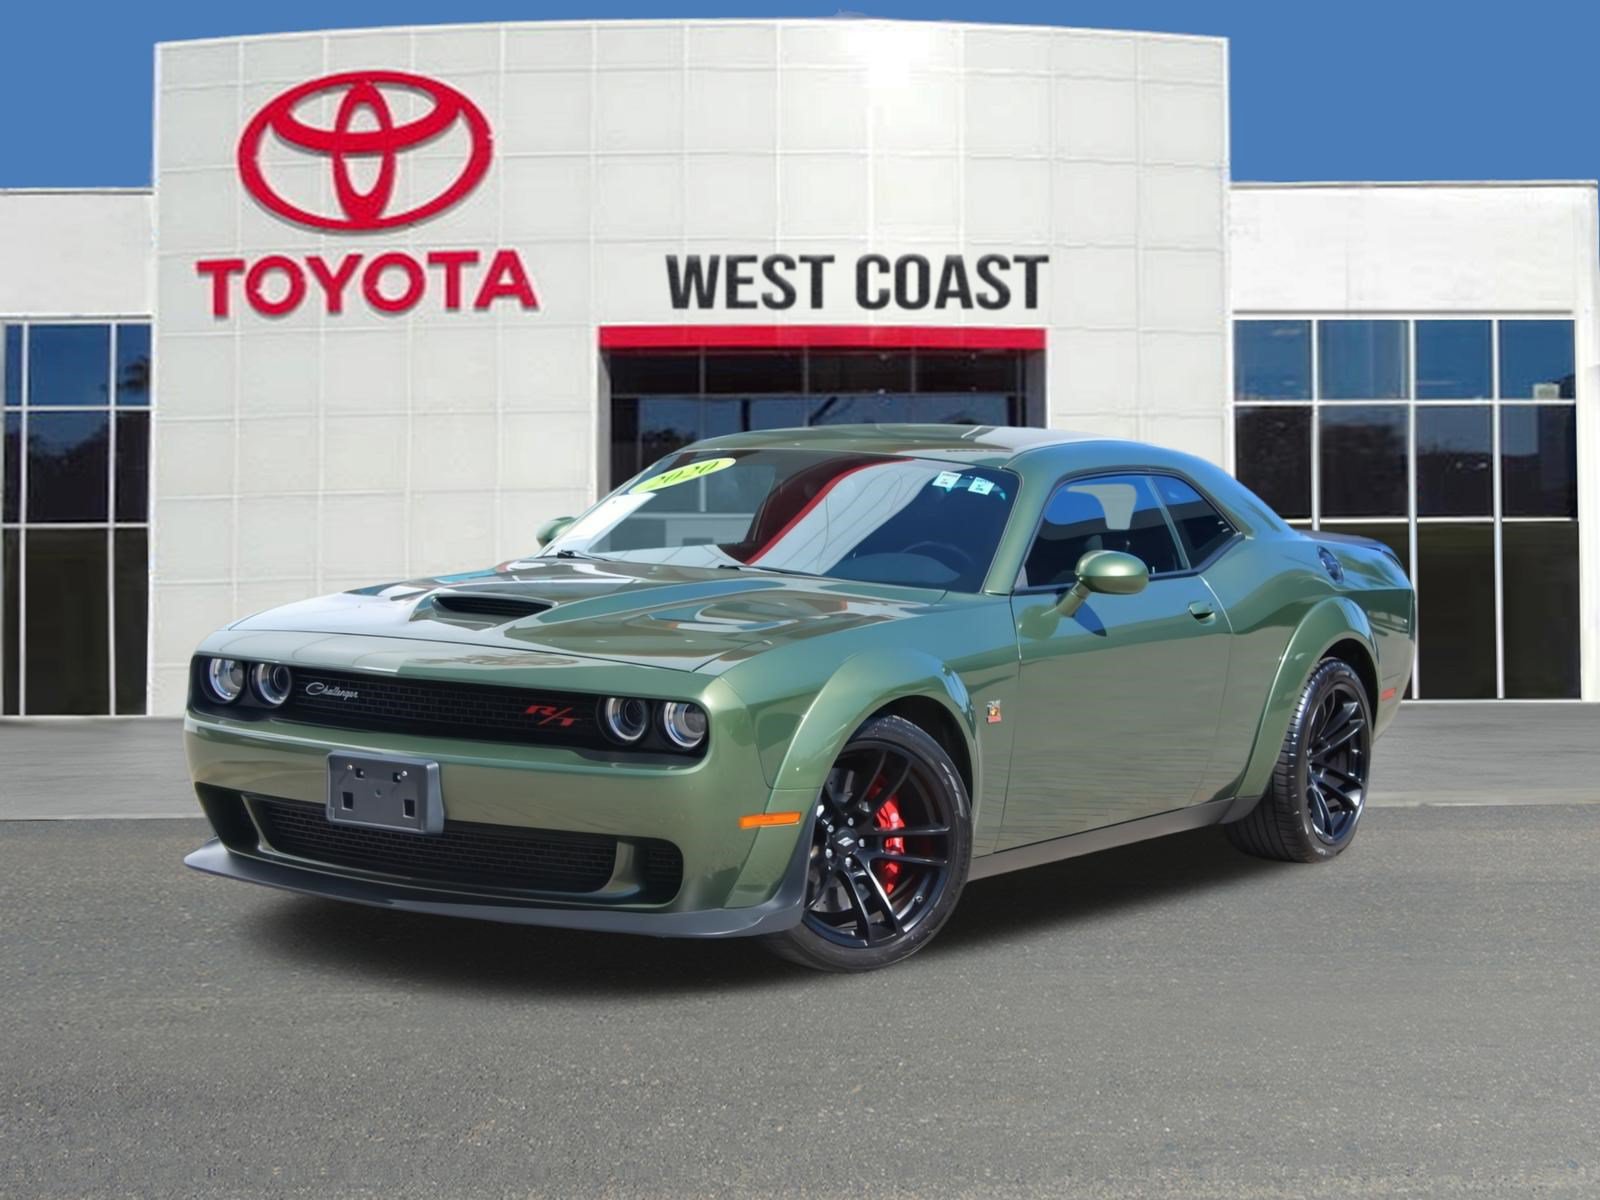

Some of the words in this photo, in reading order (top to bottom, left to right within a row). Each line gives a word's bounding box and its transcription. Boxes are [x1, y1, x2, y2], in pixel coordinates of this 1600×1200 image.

[196, 249, 539, 318] TOYOTA
[666, 254, 835, 310] WEST
[855, 253, 1050, 311] COAST
[305, 681, 359, 701] Challenger
[524, 704, 579, 727] R/T
